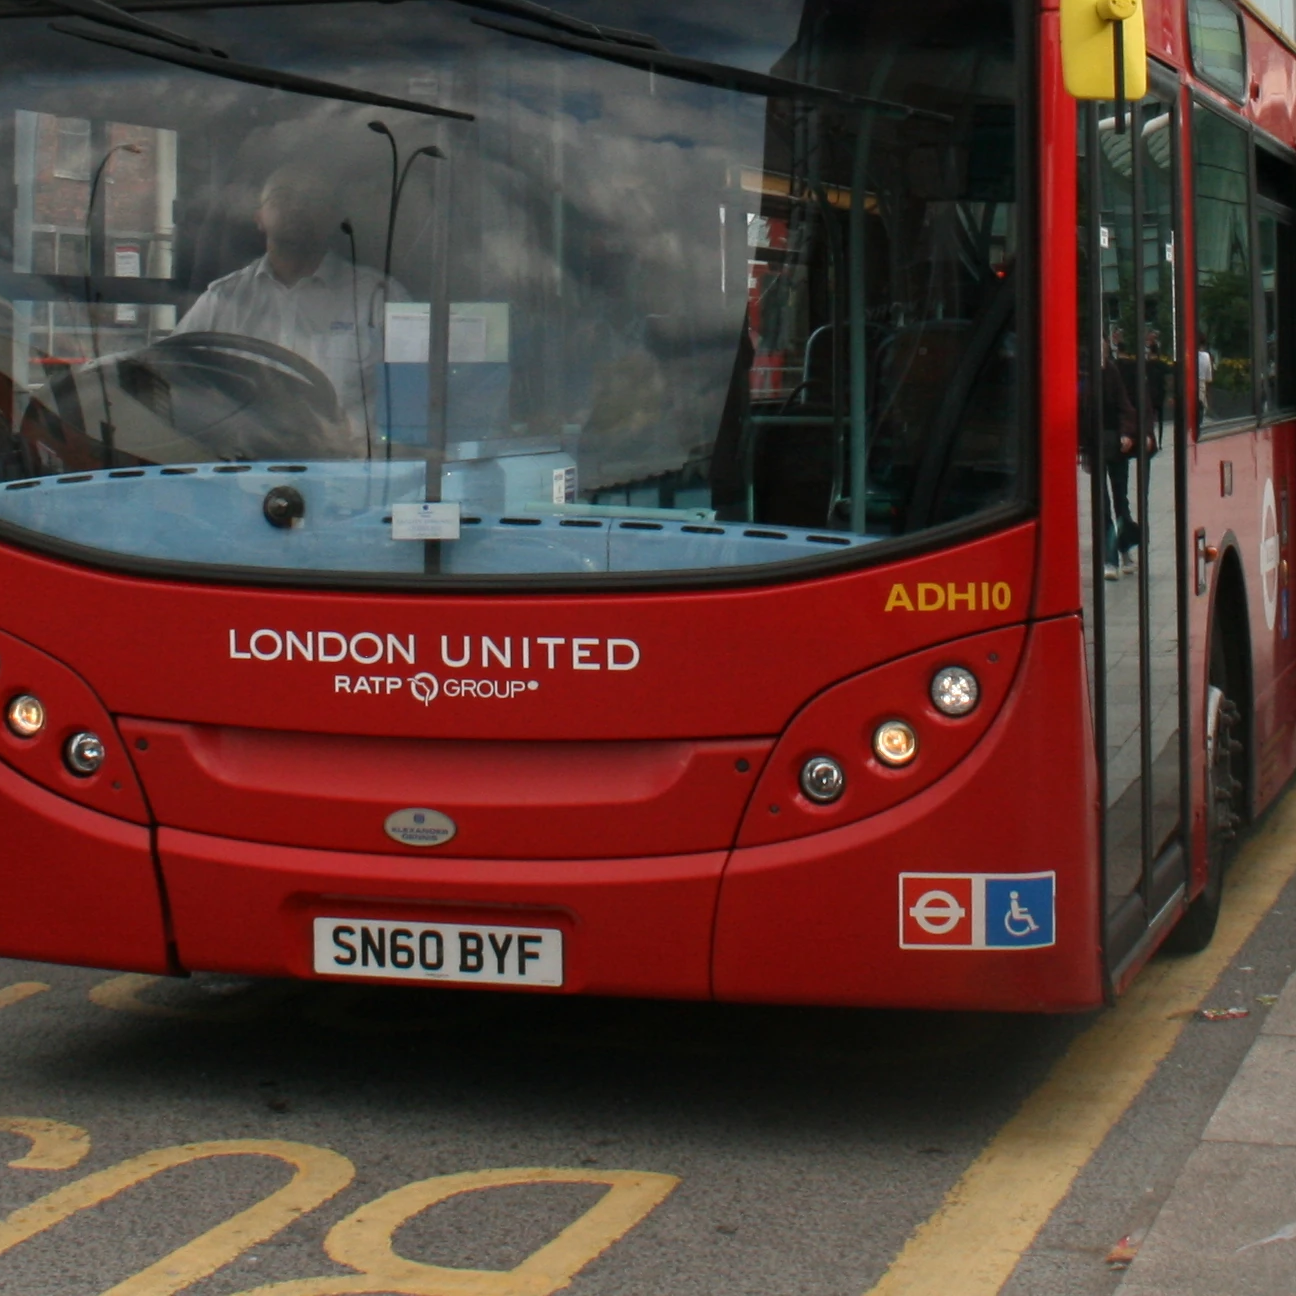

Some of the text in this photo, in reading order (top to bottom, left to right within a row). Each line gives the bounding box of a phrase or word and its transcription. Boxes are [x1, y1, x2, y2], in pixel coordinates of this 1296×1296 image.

[884, 581, 1011, 612] ADH10
[229, 628, 641, 671] LONDON UNITED
[334, 675, 526, 699] RATP GROUP
[332, 925, 542, 975] SN60 BYF
